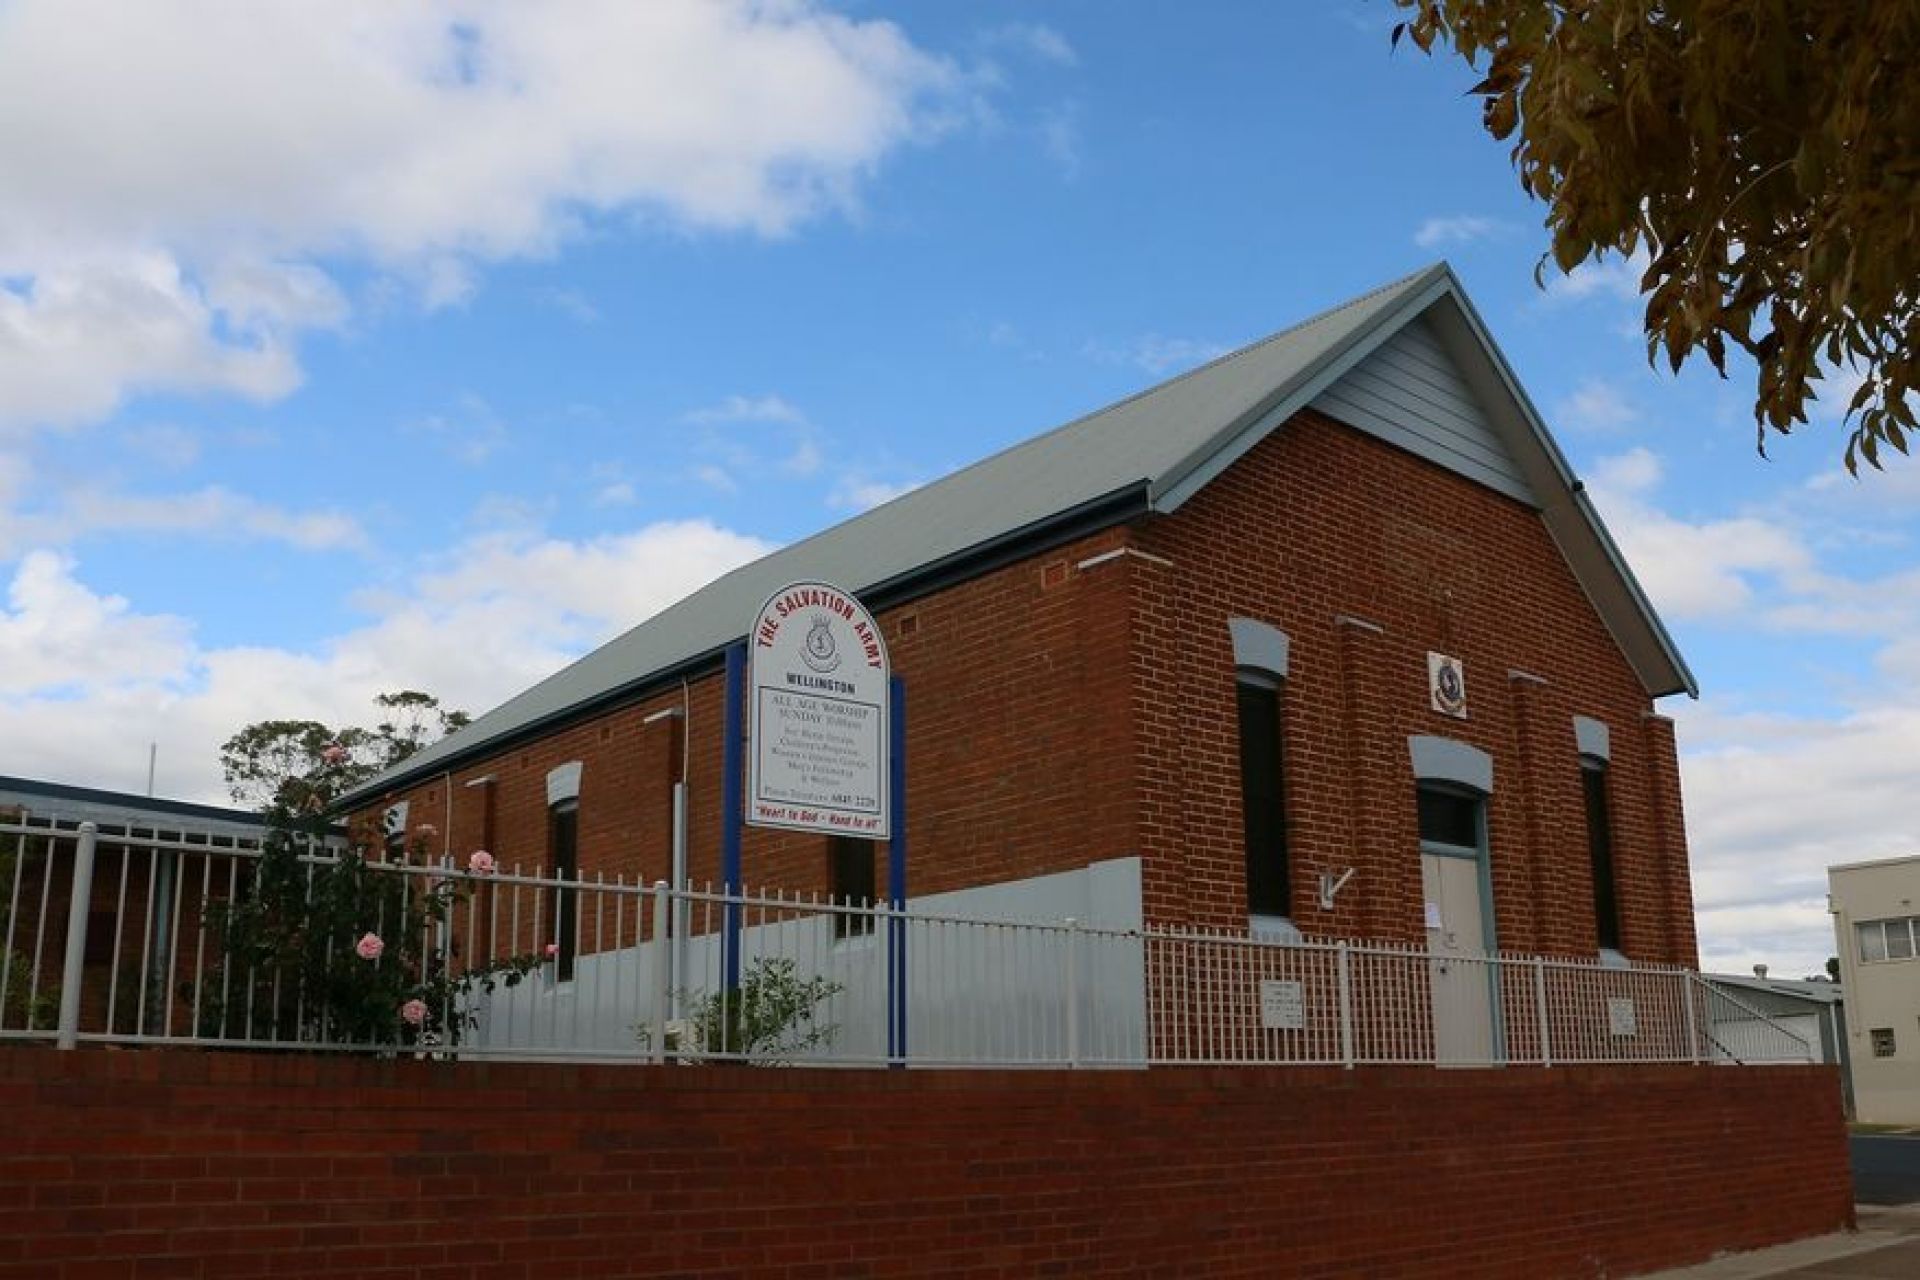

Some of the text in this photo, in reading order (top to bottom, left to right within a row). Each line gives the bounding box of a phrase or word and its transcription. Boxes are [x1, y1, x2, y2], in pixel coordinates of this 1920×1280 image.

[758, 616, 779, 647] THE
[776, 589, 856, 621] SALVATION
[854, 621, 881, 669] ARMY
[786, 672, 856, 694] WELLINGTON
[779, 708, 821, 723] SUNDAY
